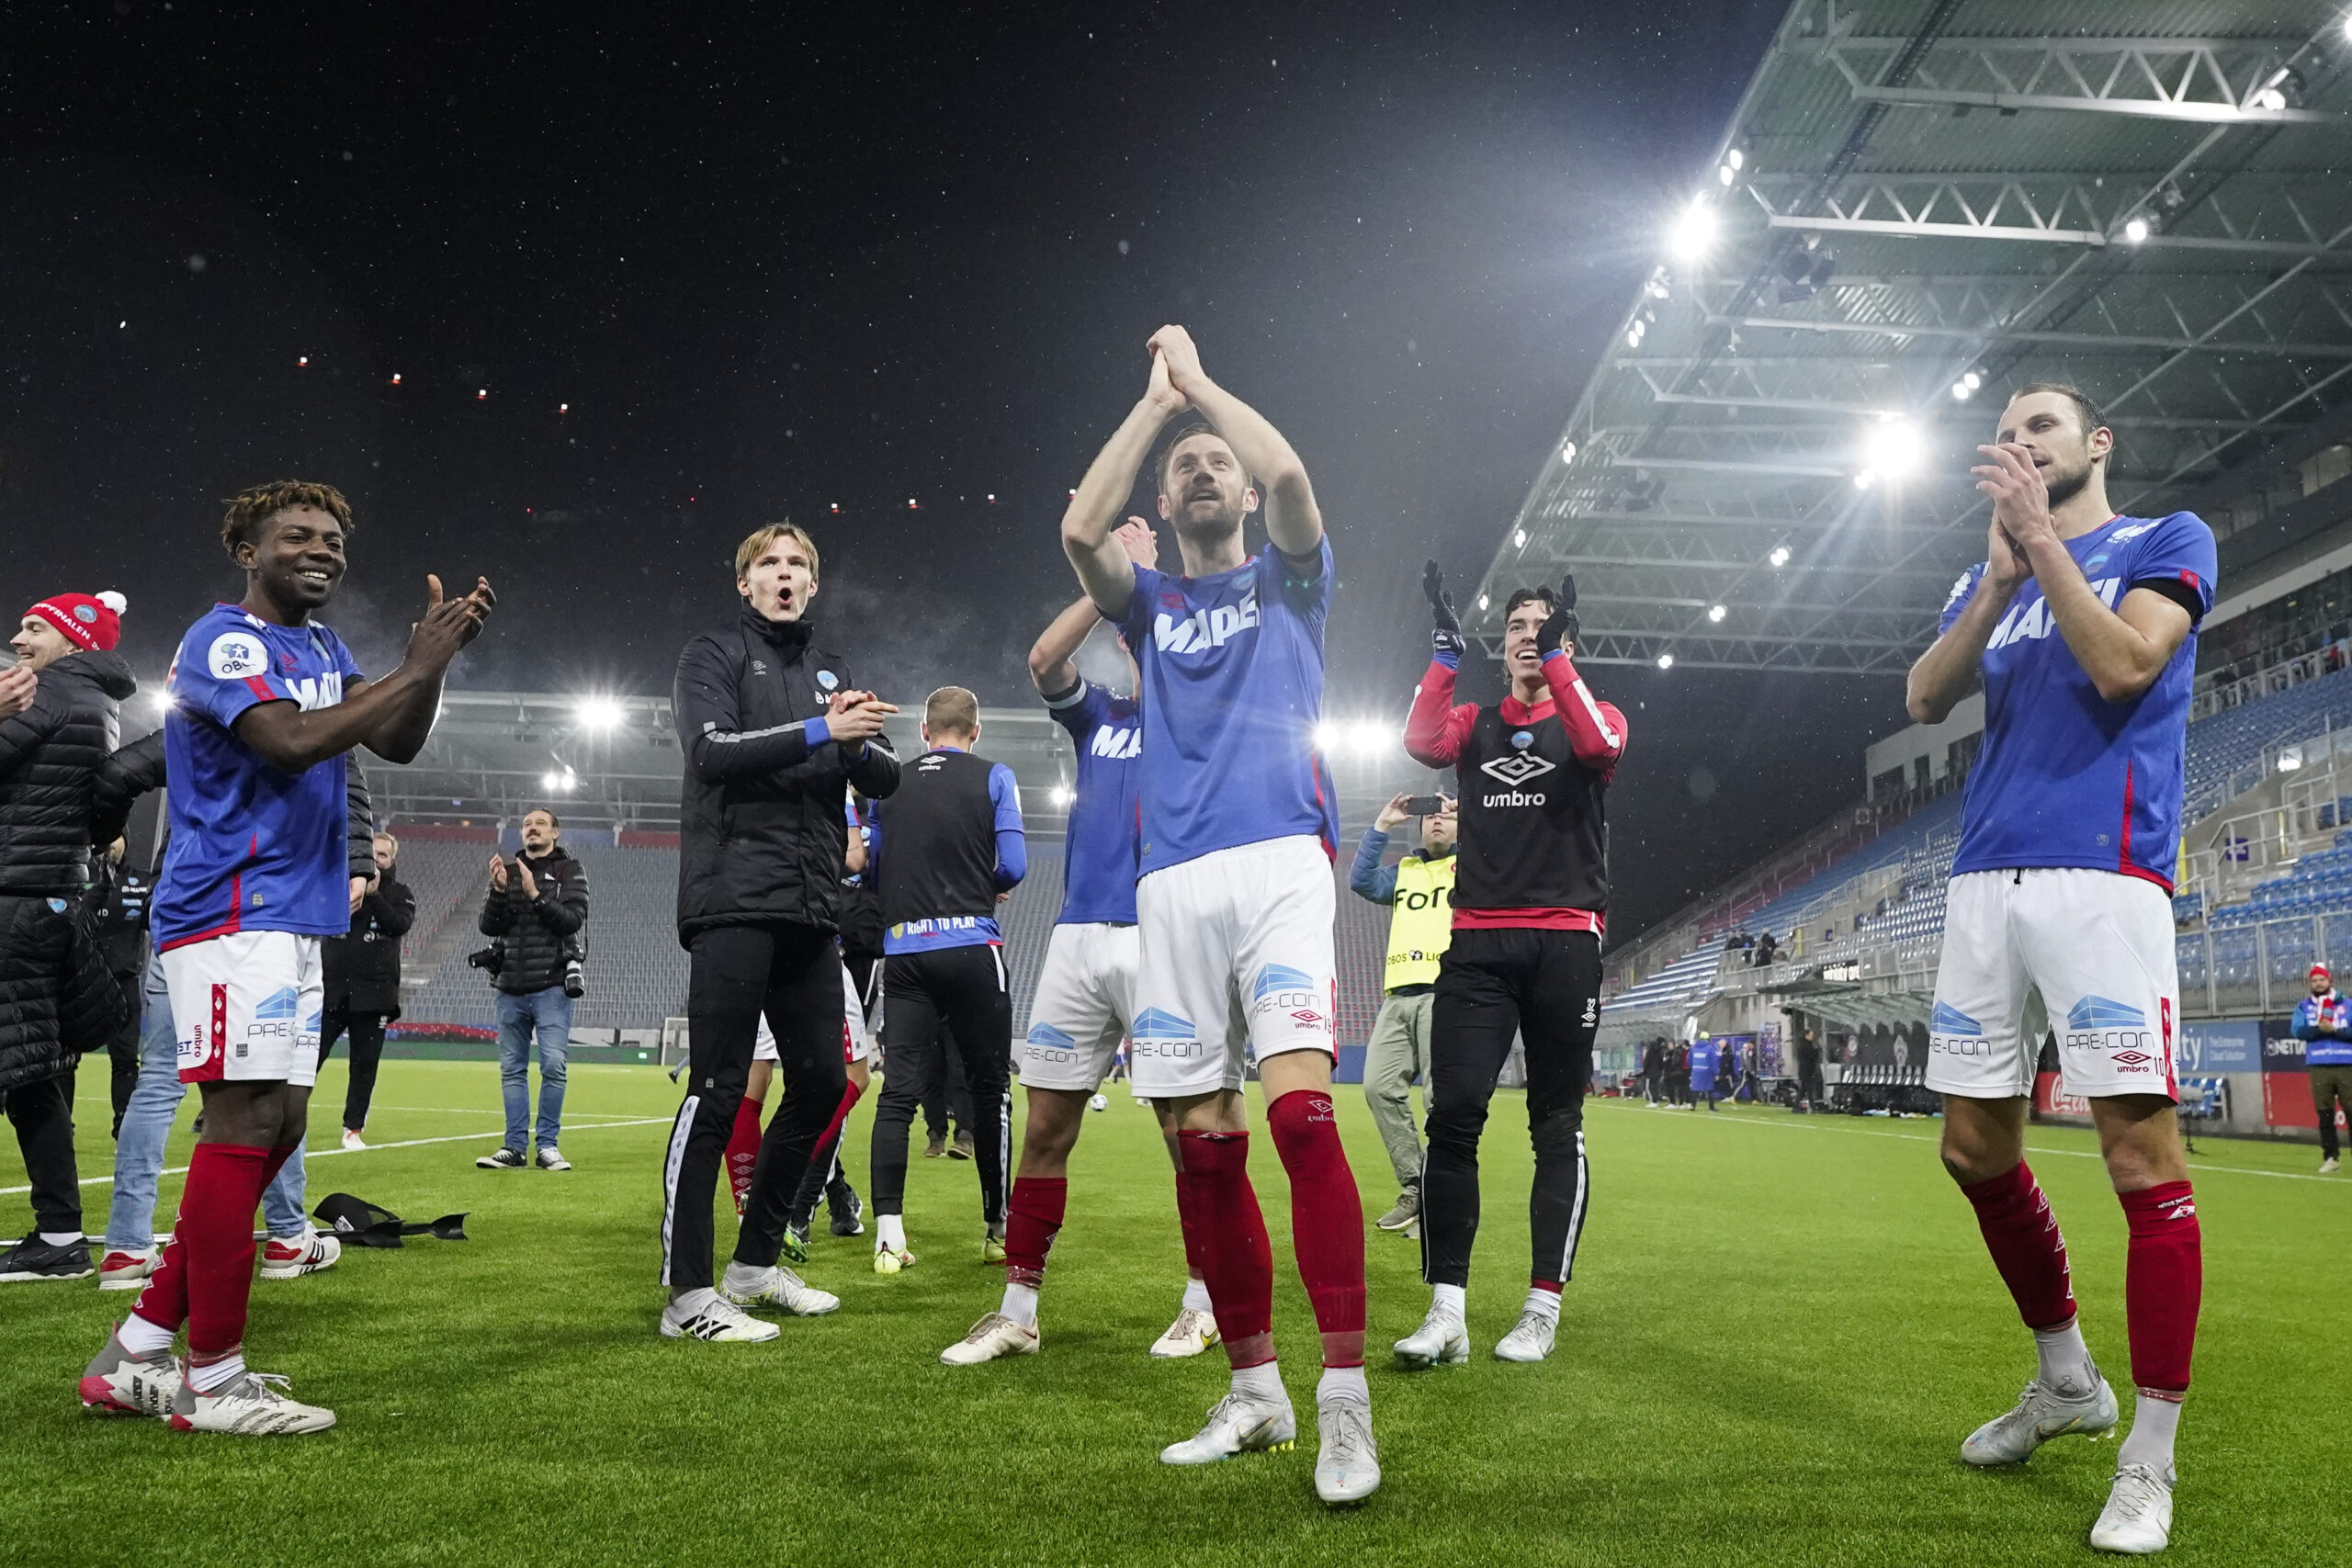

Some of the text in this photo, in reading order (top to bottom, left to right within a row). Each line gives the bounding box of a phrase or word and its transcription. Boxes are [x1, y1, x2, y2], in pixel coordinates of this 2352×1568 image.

[1483, 790, 1546, 807] umbro
[907, 919, 933, 935] RIGHT
[935, 918, 950, 931] TO
[952, 916, 976, 930] PLAY
[1586, 998, 1596, 1012] 32
[1295, 1021, 1321, 1031] umbro
[194, 1024, 204, 1057] umbro
[2067, 1032, 2154, 1051] PRE-CON
[2117, 1066, 2150, 1074] umbro
[2154, 1057, 2165, 1077] 10
